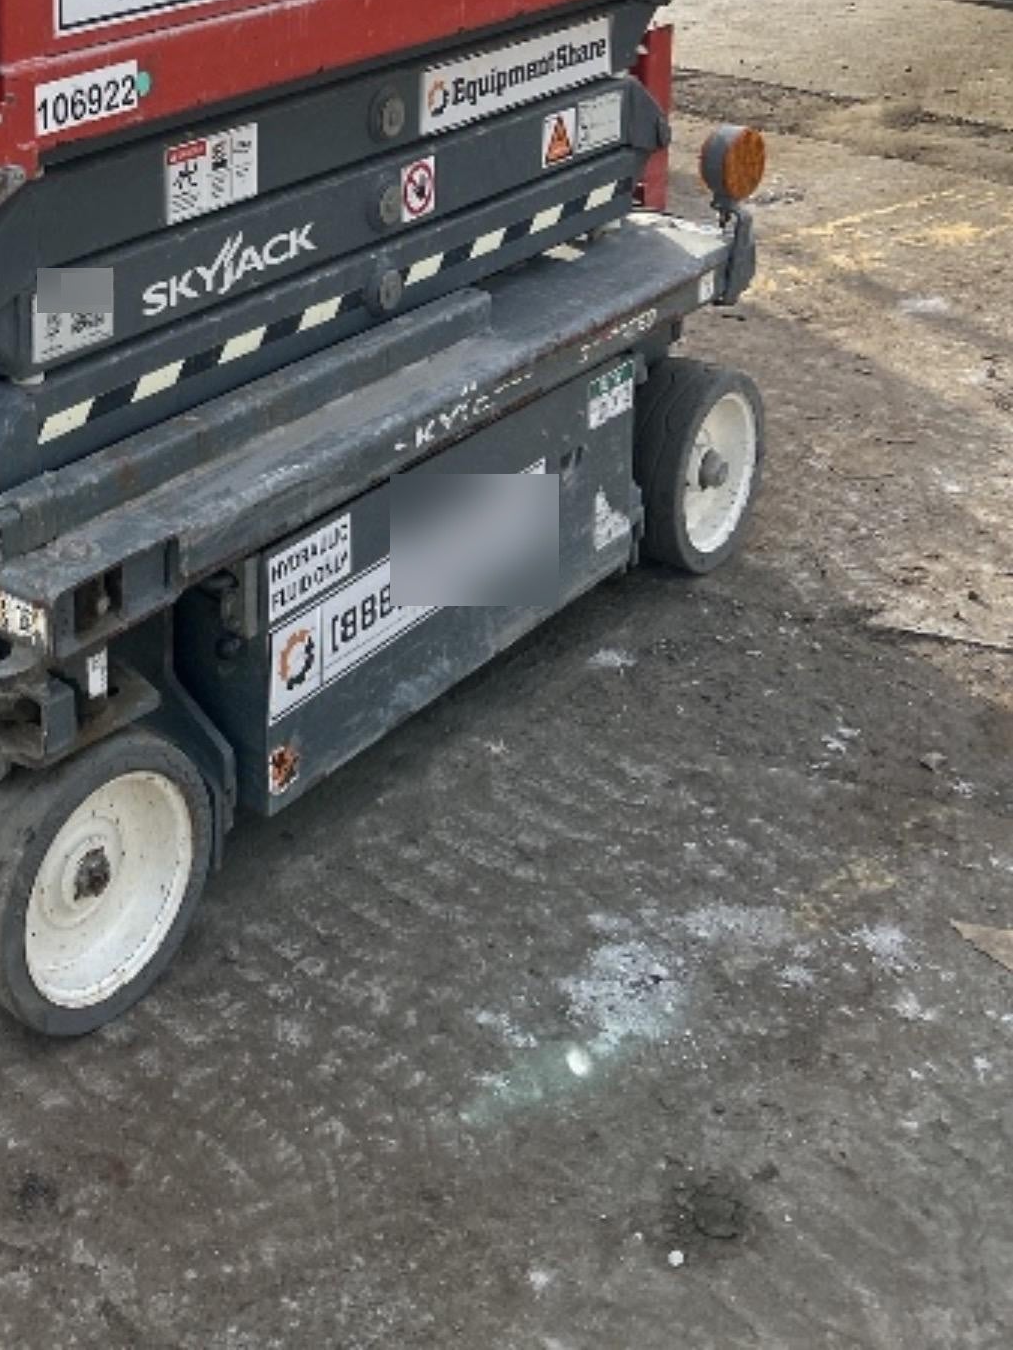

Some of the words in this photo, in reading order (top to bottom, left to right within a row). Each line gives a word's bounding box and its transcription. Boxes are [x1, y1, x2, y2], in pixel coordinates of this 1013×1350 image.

[37, 75, 136, 132] 106922
[451, 36, 607, 106] EquipmentShare
[142, 222, 317, 317] SKYJACK
